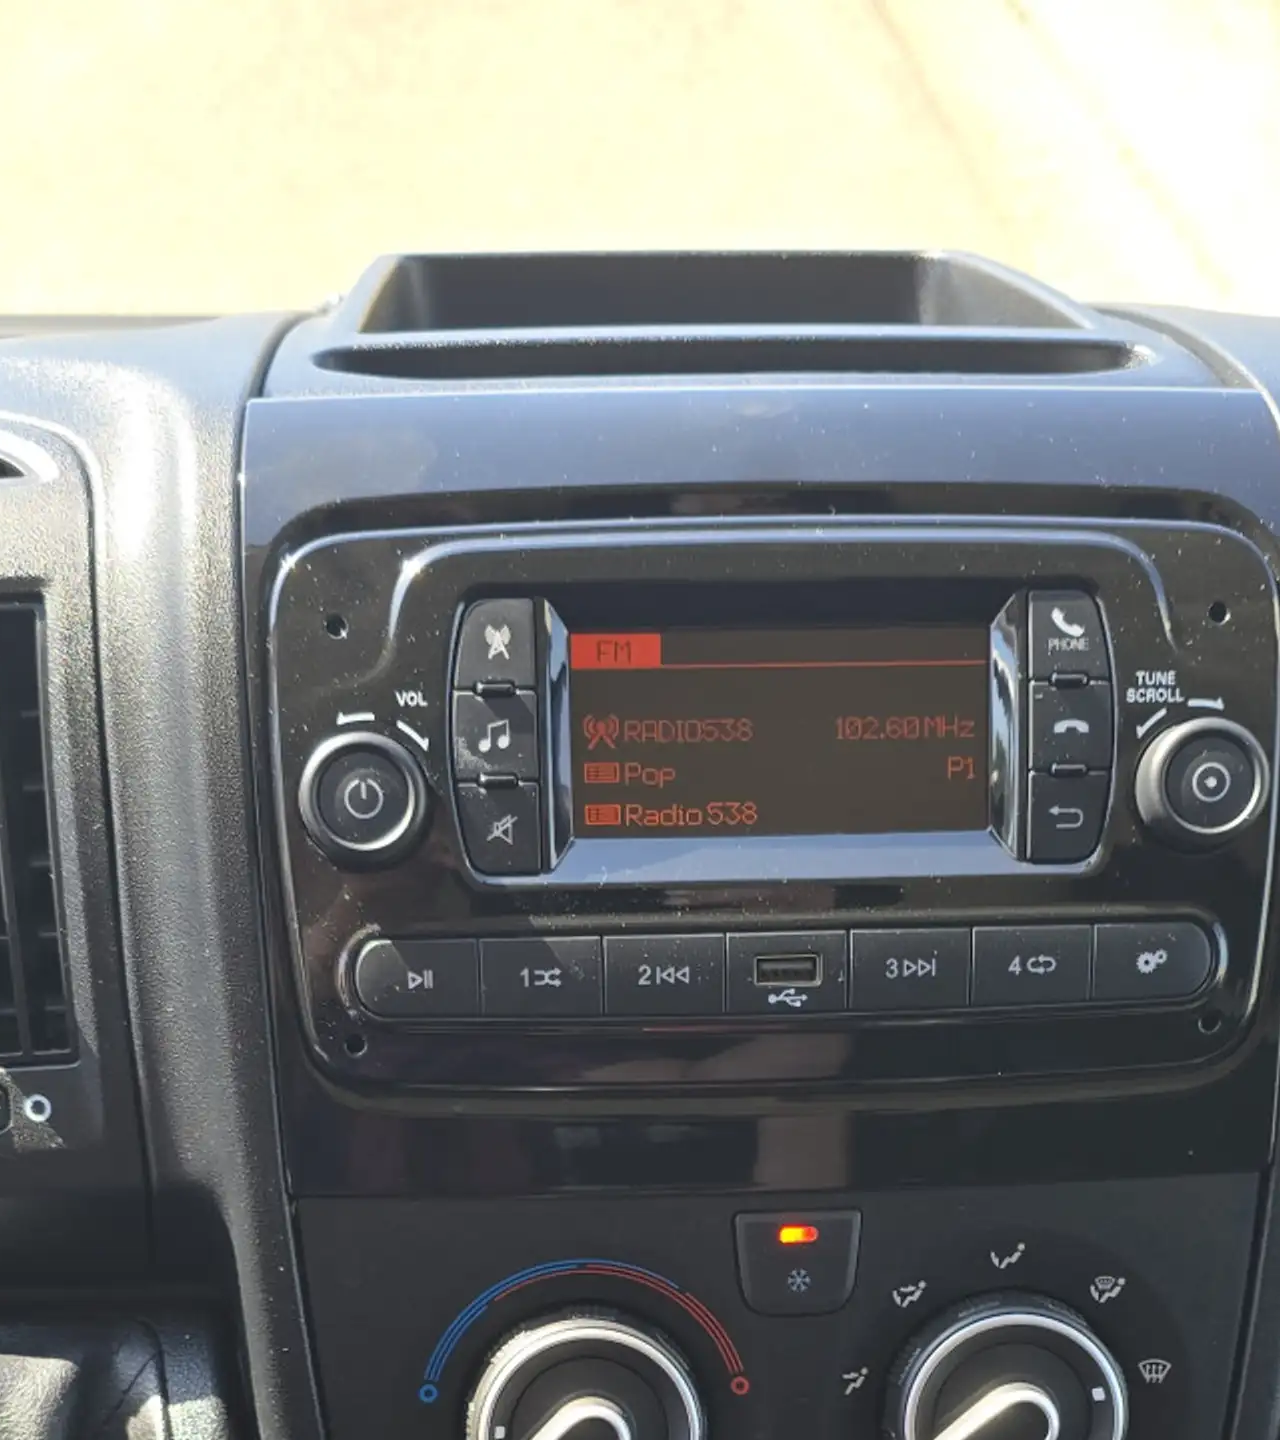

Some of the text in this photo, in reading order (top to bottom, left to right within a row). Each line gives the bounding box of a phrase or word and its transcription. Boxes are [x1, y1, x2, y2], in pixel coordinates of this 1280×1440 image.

[596, 640, 632, 663] FM
[1047, 637, 1089, 651] PHONE
[1136, 670, 1176, 685] TUNE
[395, 690, 428, 707] VOL
[1126, 688, 1185, 703] SCROLL
[624, 718, 753, 743] RADIO538
[624, 762, 676, 788] Pop
[947, 756, 975, 780] P1
[626, 801, 758, 827] Radio 538
[638, 965, 651, 986] 2
[885, 958, 898, 979] 3
[1008, 956, 1021, 975] 4
[519, 967, 531, 987] 1
